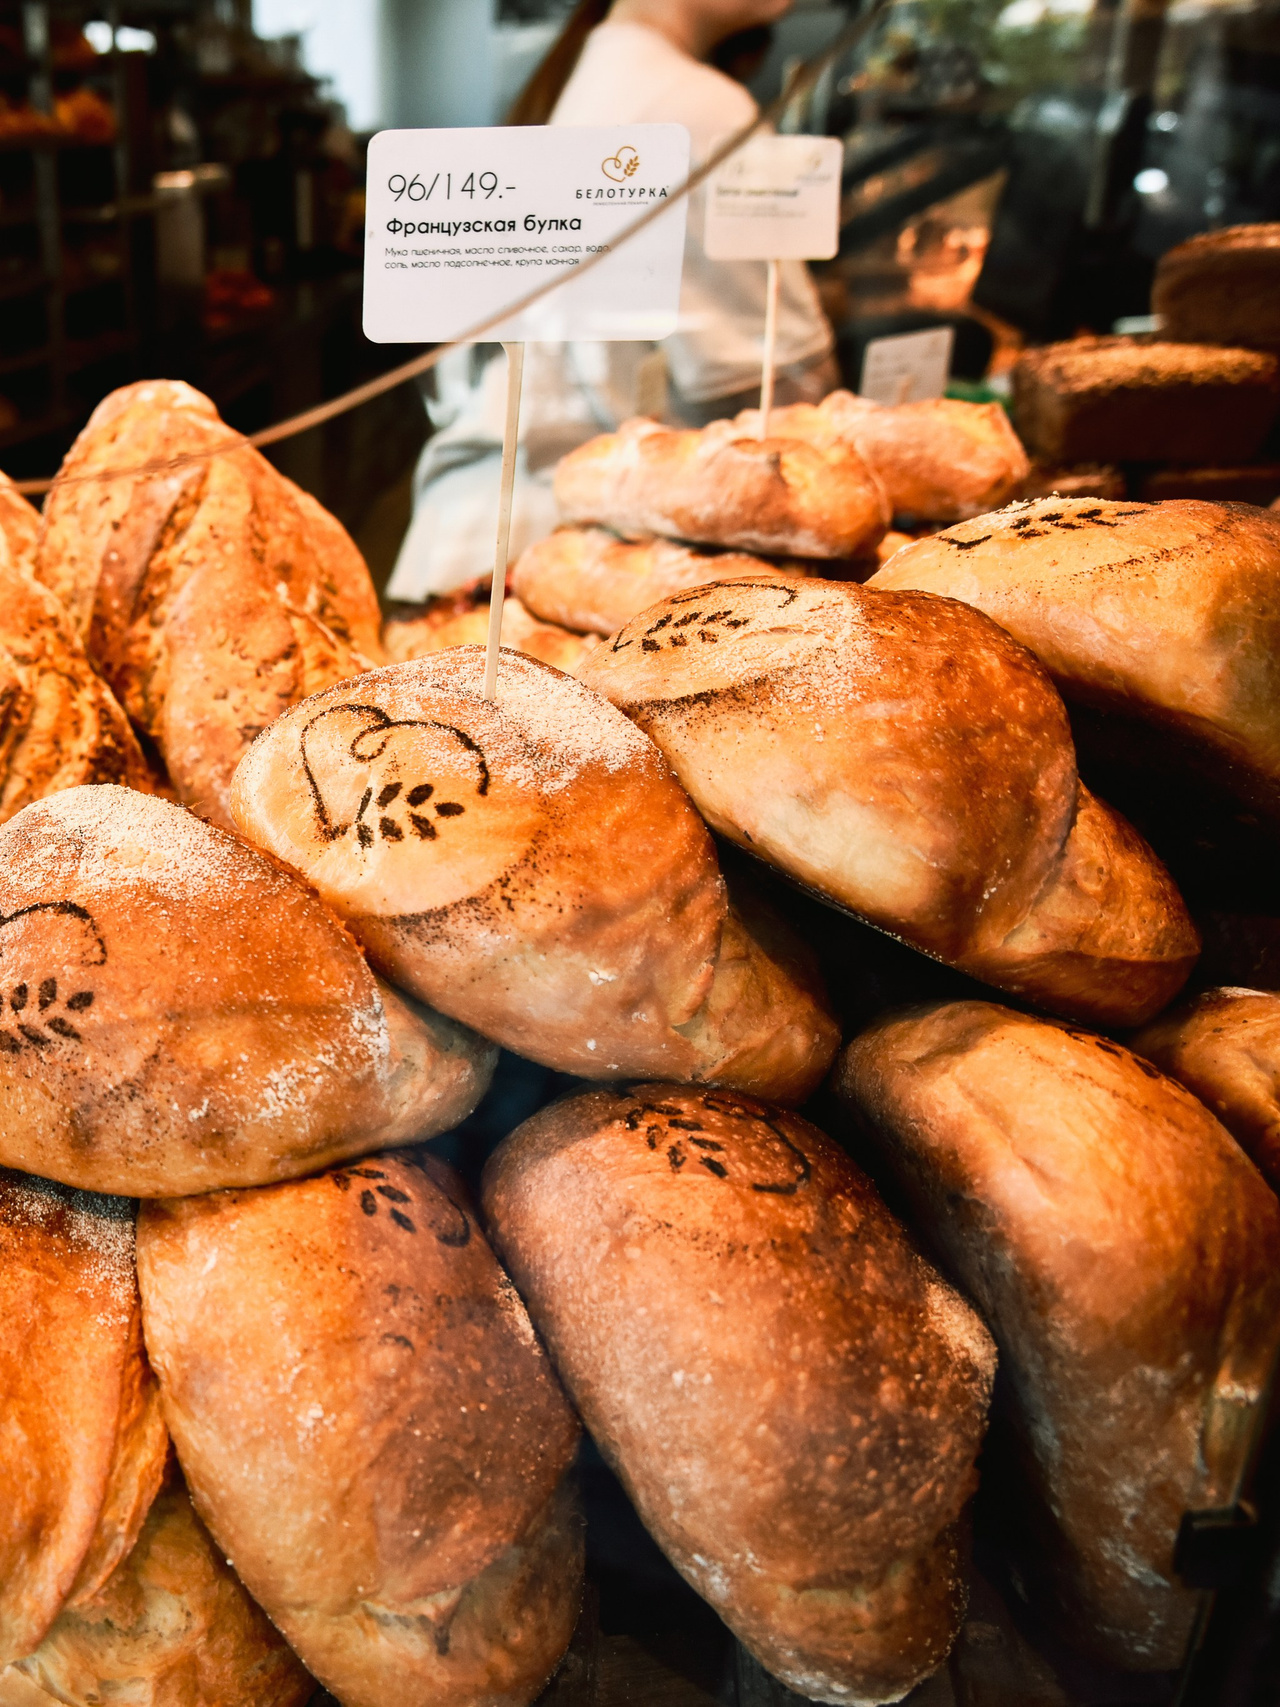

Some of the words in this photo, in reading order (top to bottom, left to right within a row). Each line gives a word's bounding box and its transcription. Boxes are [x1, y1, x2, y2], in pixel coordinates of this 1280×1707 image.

[575, 187, 669, 200] БЕЛОТУРКА
[386, 217, 517, 238] Французская
[523, 214, 582, 235] булка
[384, 247, 409, 258] Мука
[464, 246, 495, 255] масло
[410, 260, 441, 269] масло
[515, 258, 543, 268] крупа
[545, 257, 580, 266] манная
